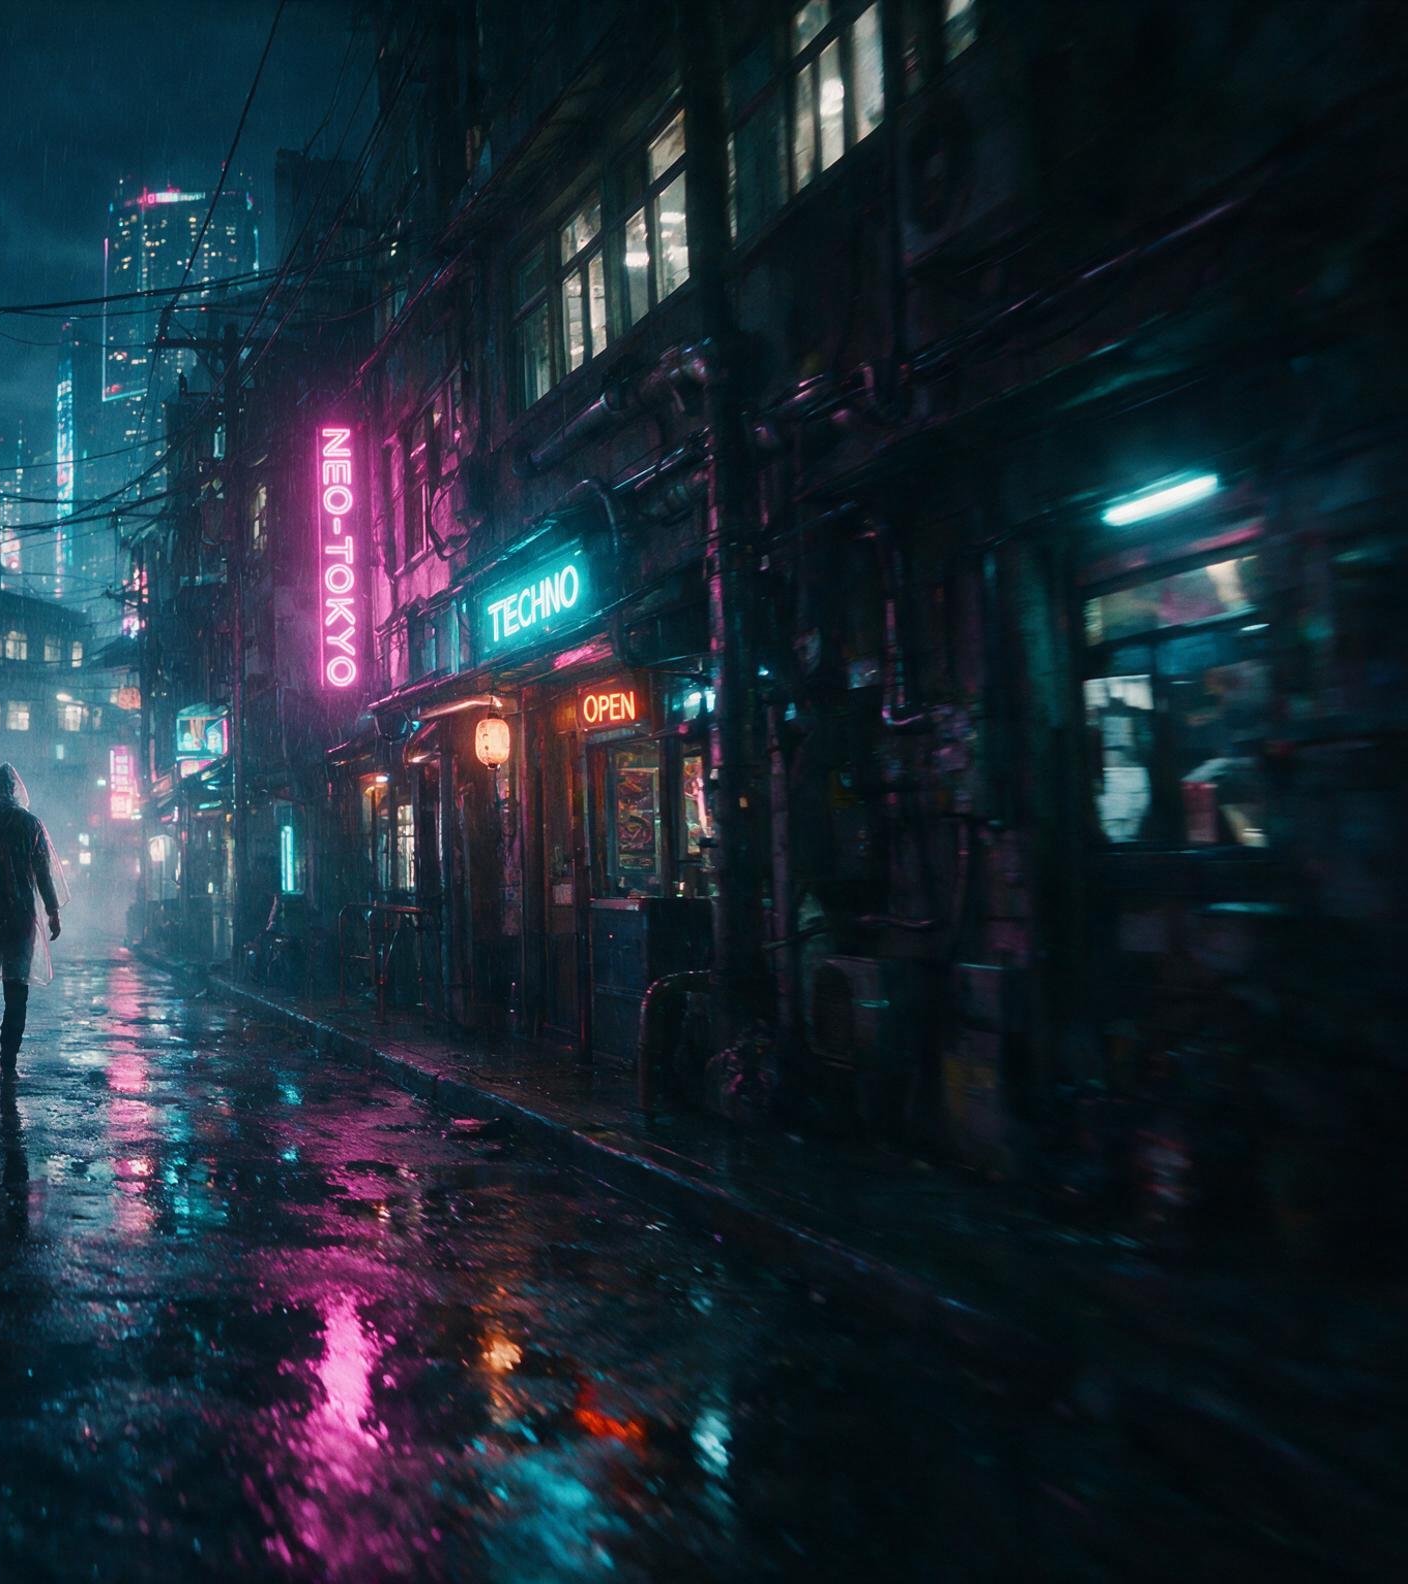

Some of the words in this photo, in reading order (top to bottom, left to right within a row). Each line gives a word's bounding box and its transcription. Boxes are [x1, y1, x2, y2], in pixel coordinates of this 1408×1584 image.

[322, 427, 357, 688] NEO-TOKYO
[487, 564, 580, 643] TECHNO
[583, 691, 637, 724] OPEN
